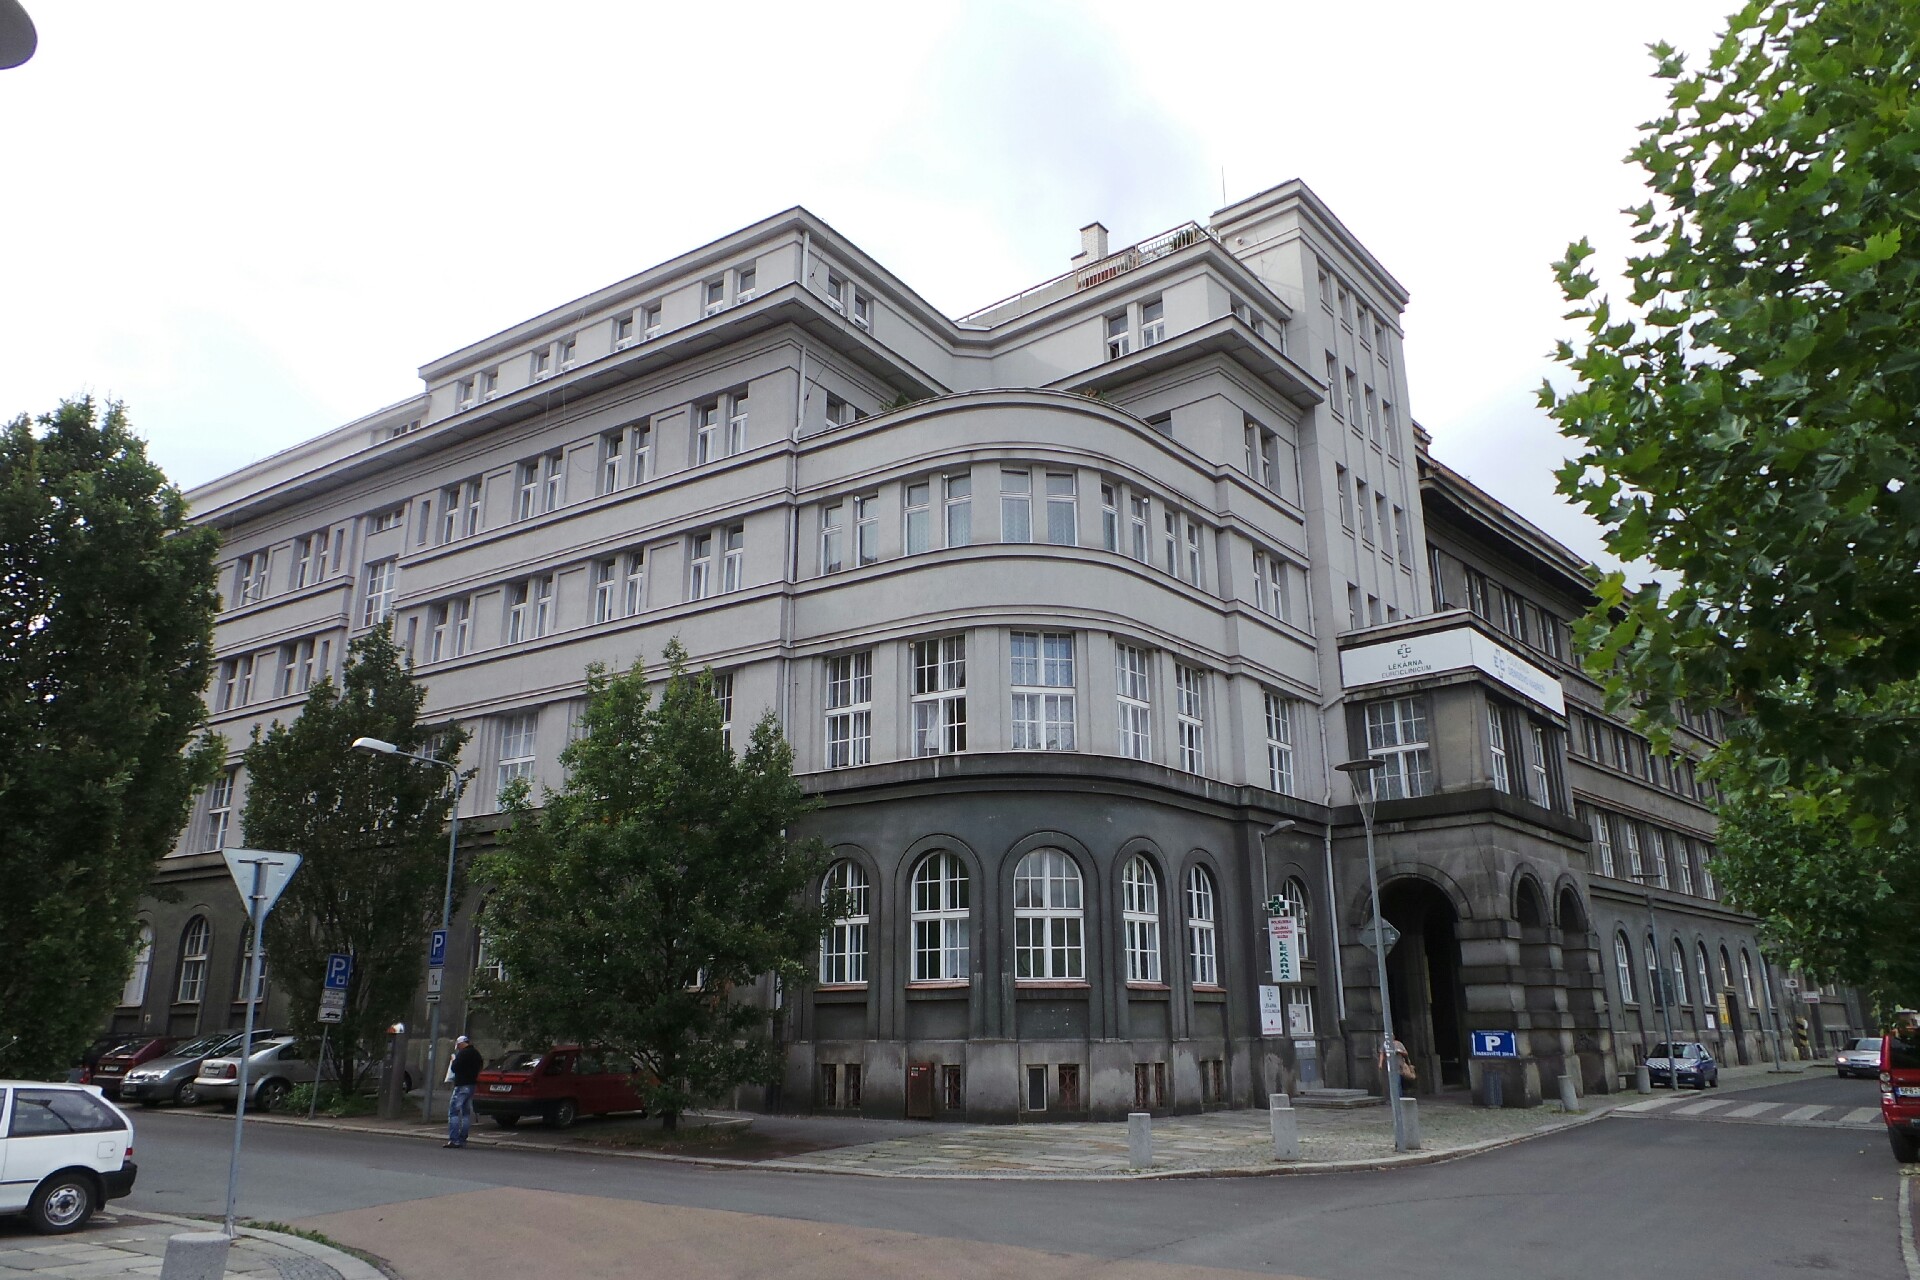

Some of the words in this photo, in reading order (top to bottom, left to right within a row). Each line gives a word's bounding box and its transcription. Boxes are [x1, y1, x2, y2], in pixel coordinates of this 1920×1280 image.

[1381, 665, 1432, 679] EUROCLINICUM
[433, 935, 444, 956] P
[331, 958, 346, 978] P
[1485, 1035, 1501, 1052] P
